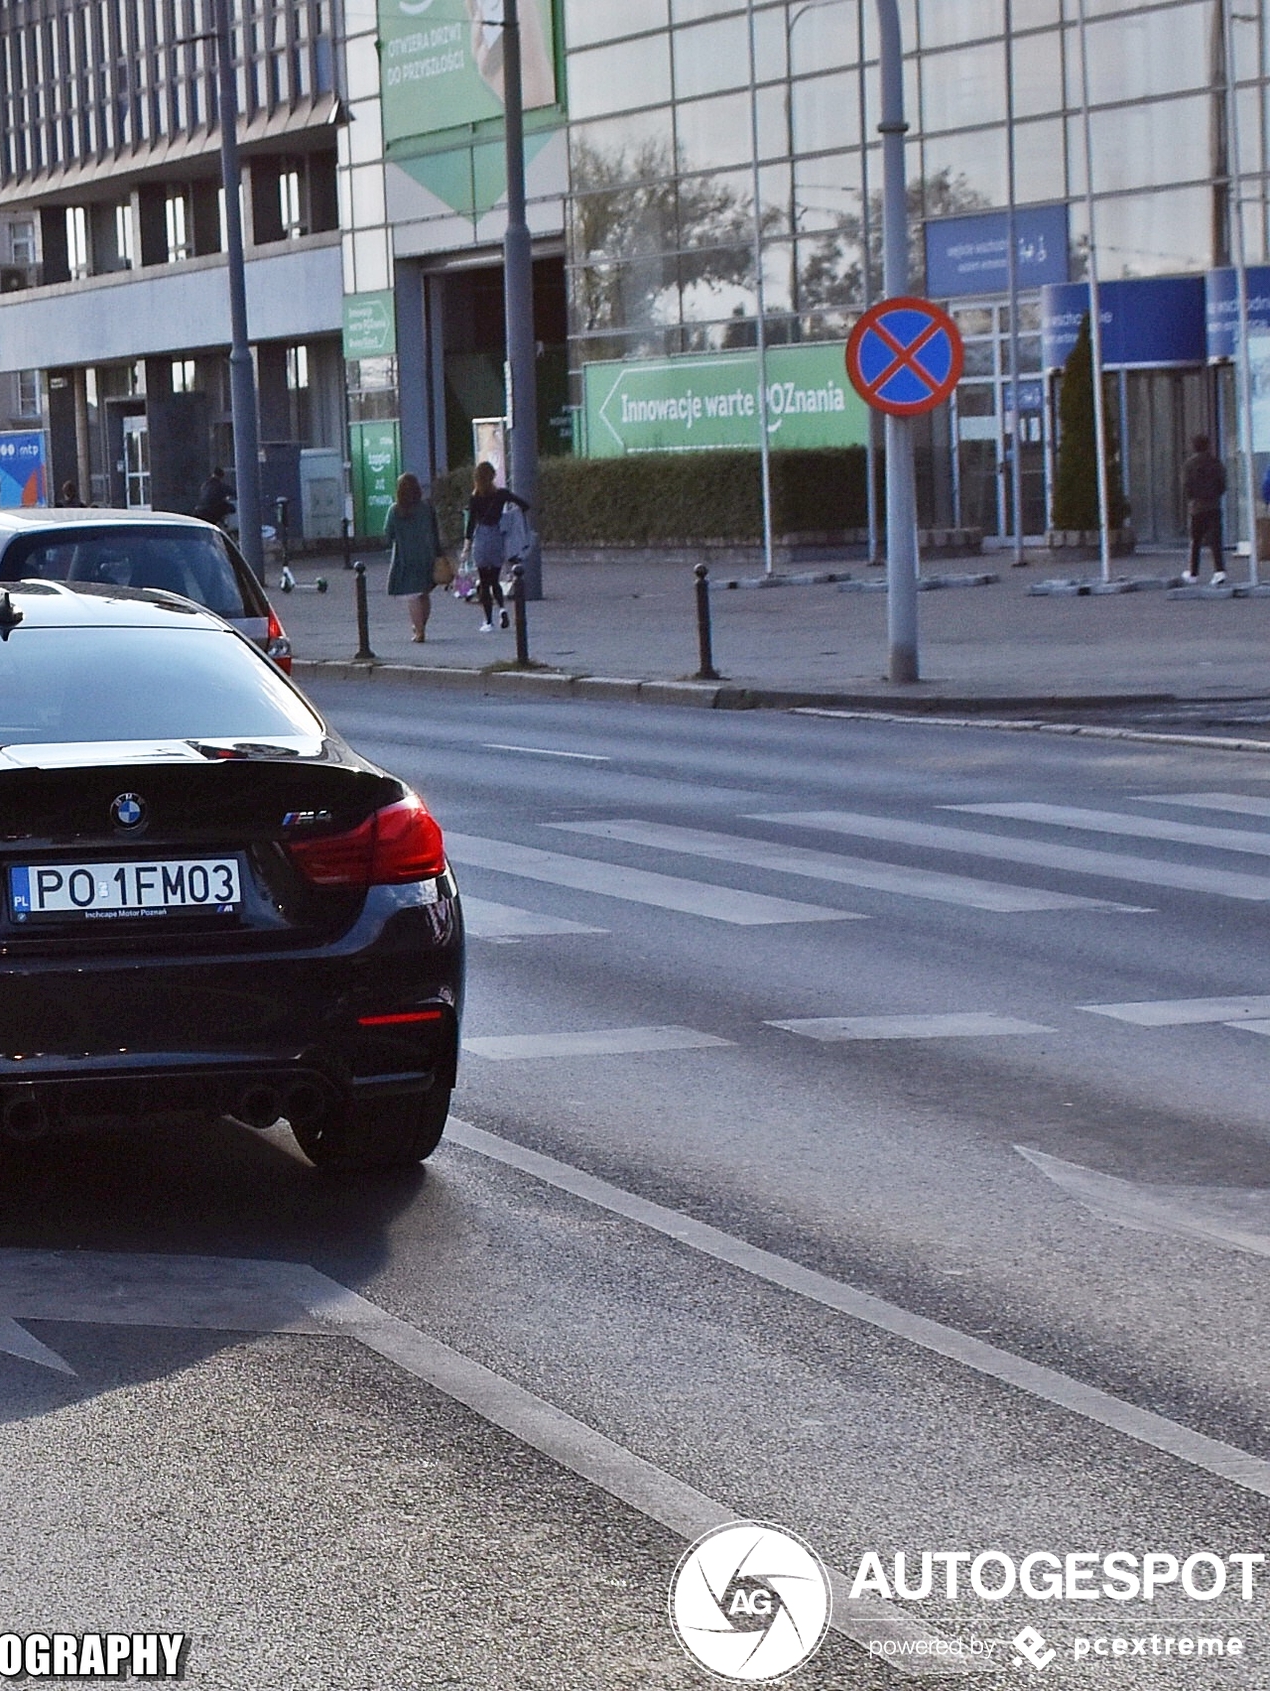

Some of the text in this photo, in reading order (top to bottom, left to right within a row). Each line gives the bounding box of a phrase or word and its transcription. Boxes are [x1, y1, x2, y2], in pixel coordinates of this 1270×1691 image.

[388, 23, 461, 57] OTWIERA DRZWI
[387, 66, 402, 85] DO
[621, 389, 702, 429] Innowacje
[704, 387, 754, 417] warte
[37, 864, 234, 909] PO 1FM03
[14, 896, 28, 907] PL
[85, 908, 167, 919] Inchcape Motor Poznań
